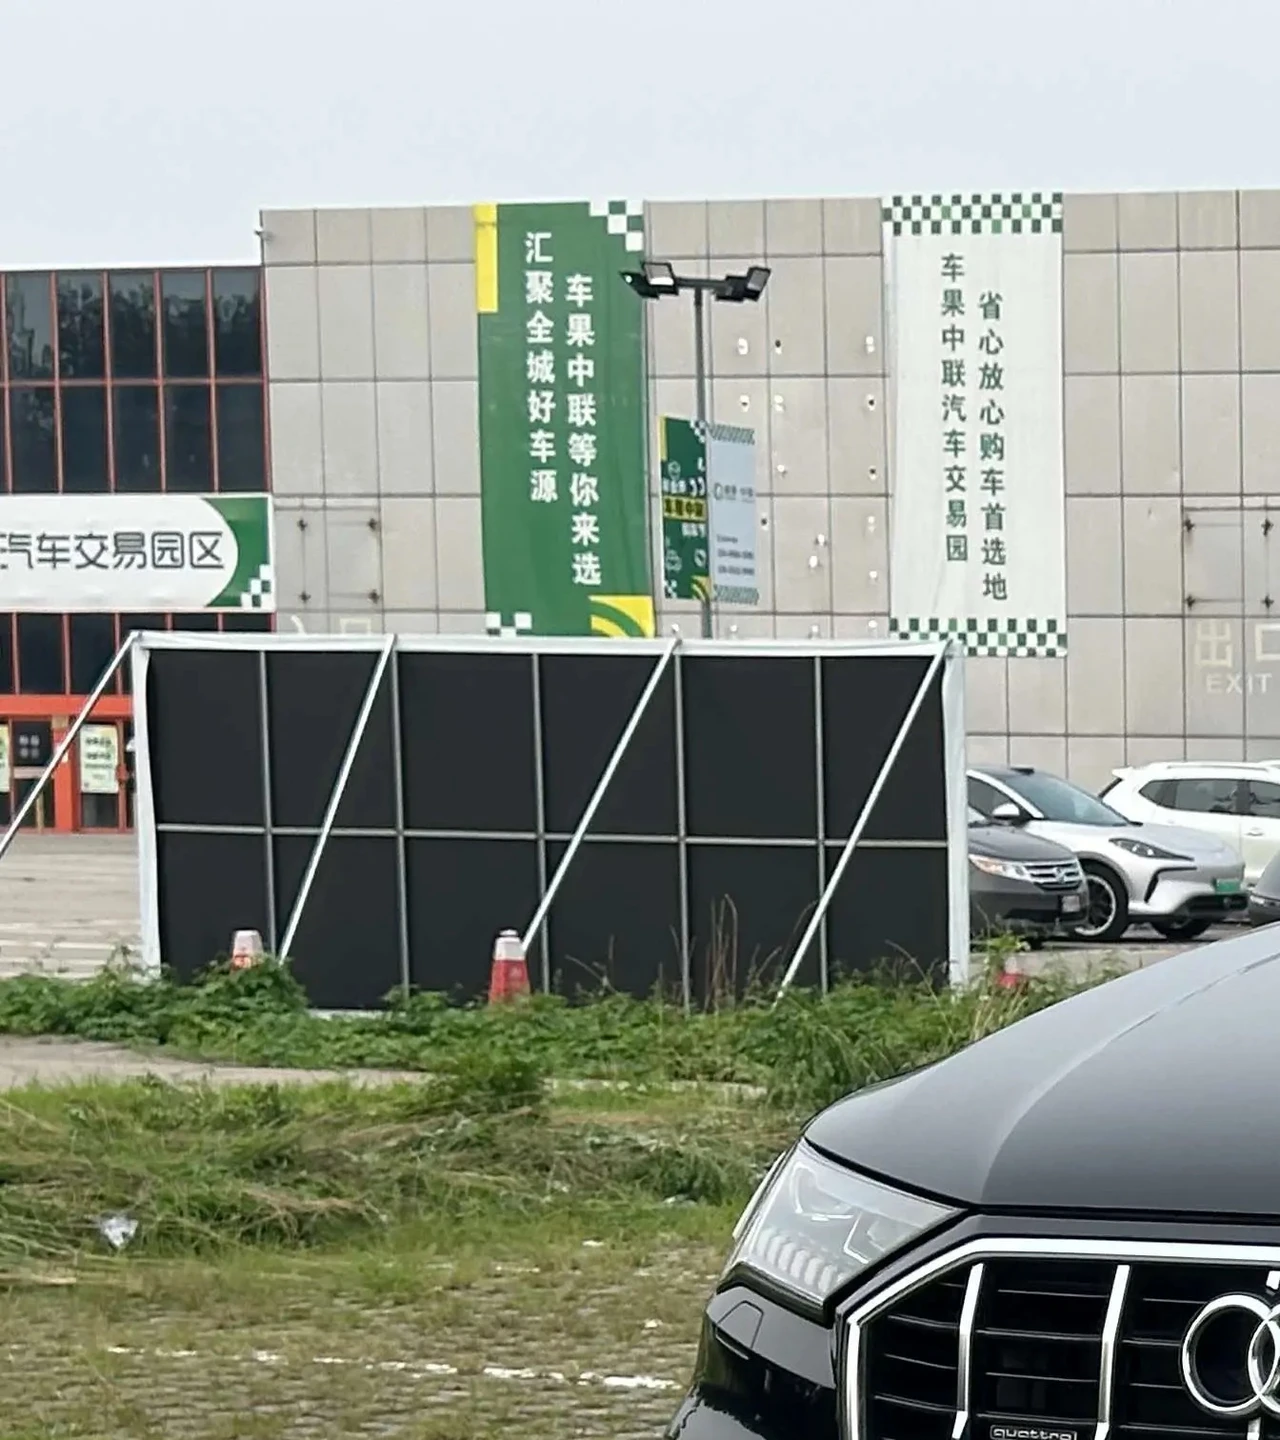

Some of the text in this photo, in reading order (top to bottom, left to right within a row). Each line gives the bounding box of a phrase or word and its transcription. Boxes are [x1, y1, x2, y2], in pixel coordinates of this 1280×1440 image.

[524, 232, 558, 502] 汇聚全城好车源
[565, 273, 601, 585] 车果中联等你来选
[941, 252, 969, 562] 车果中联汽车交易园
[978, 290, 1007, 601] 省心放心购车首选地
[0, 531, 225, 570] 汽车交易园区
[1206, 672, 1273, 694] EXIT
